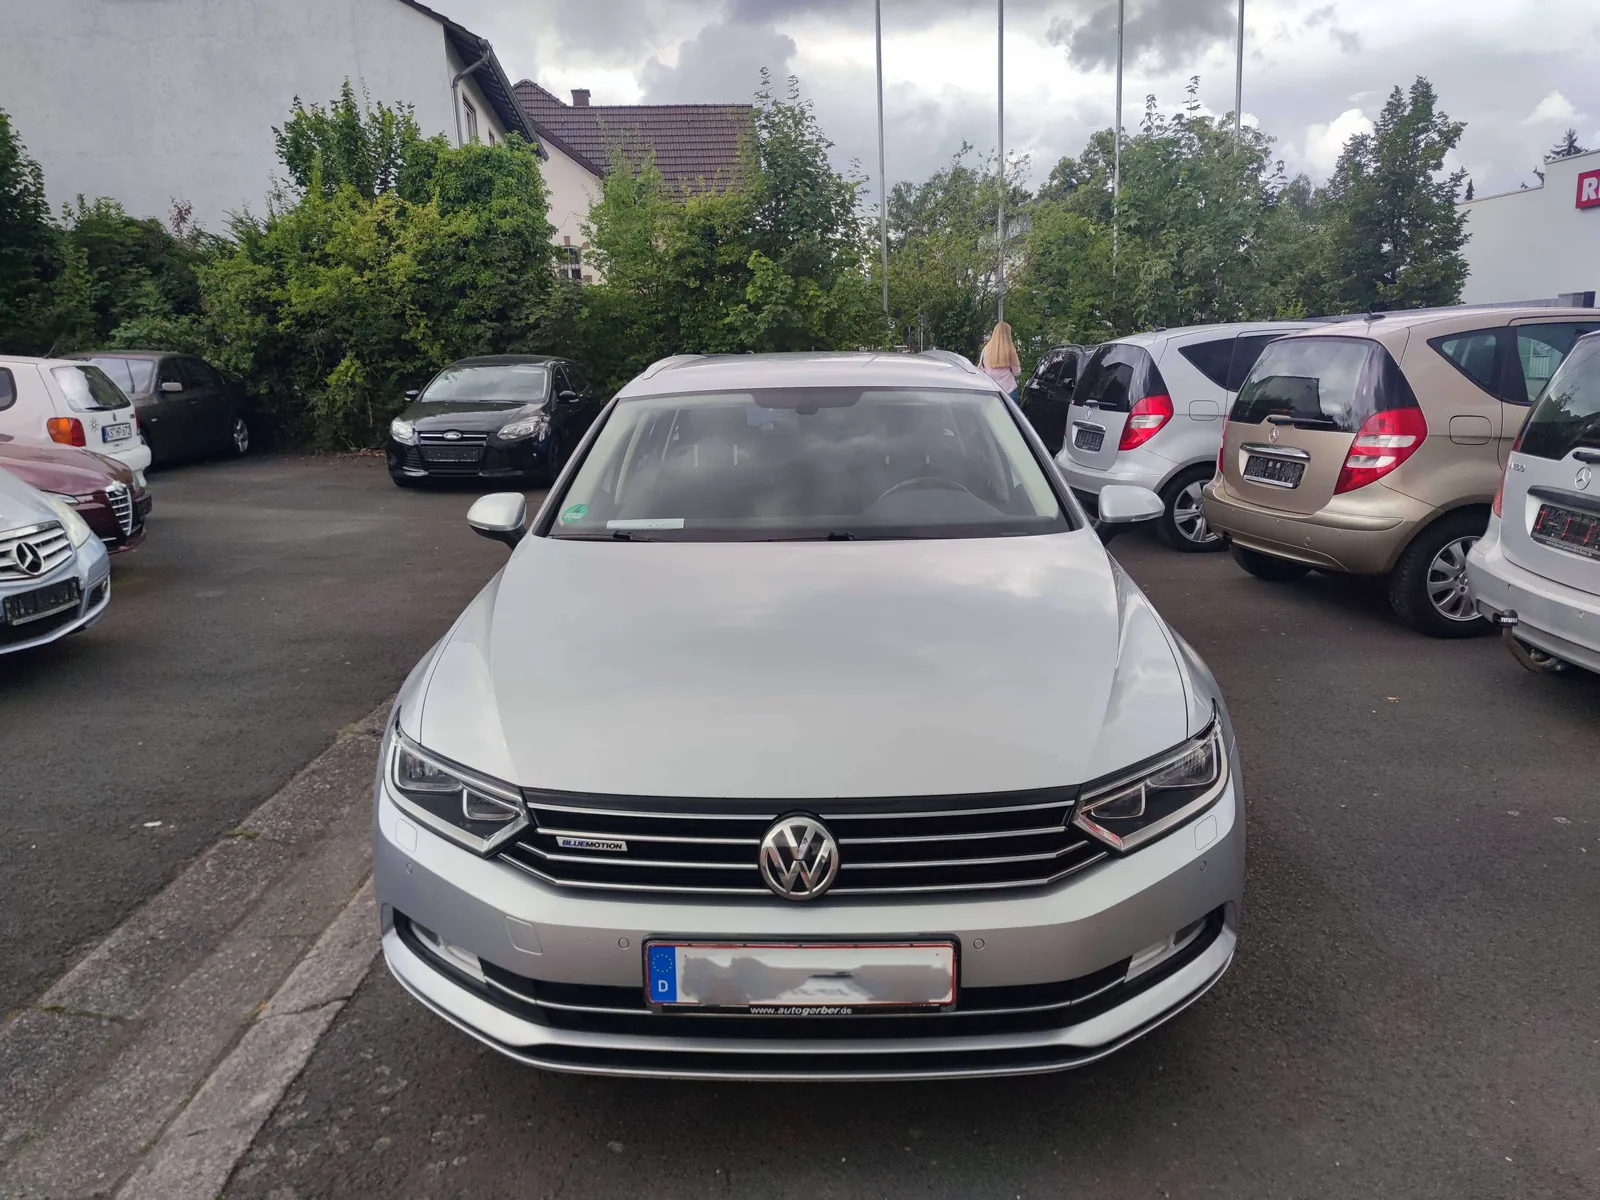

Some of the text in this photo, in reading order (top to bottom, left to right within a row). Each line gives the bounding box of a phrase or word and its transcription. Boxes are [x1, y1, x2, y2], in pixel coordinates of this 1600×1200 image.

[1582, 177, 1600, 202] R
[562, 839, 623, 850] BLUEMOTION
[658, 979, 669, 993] D
[750, 1005, 853, 1016] www.autogerber.de
